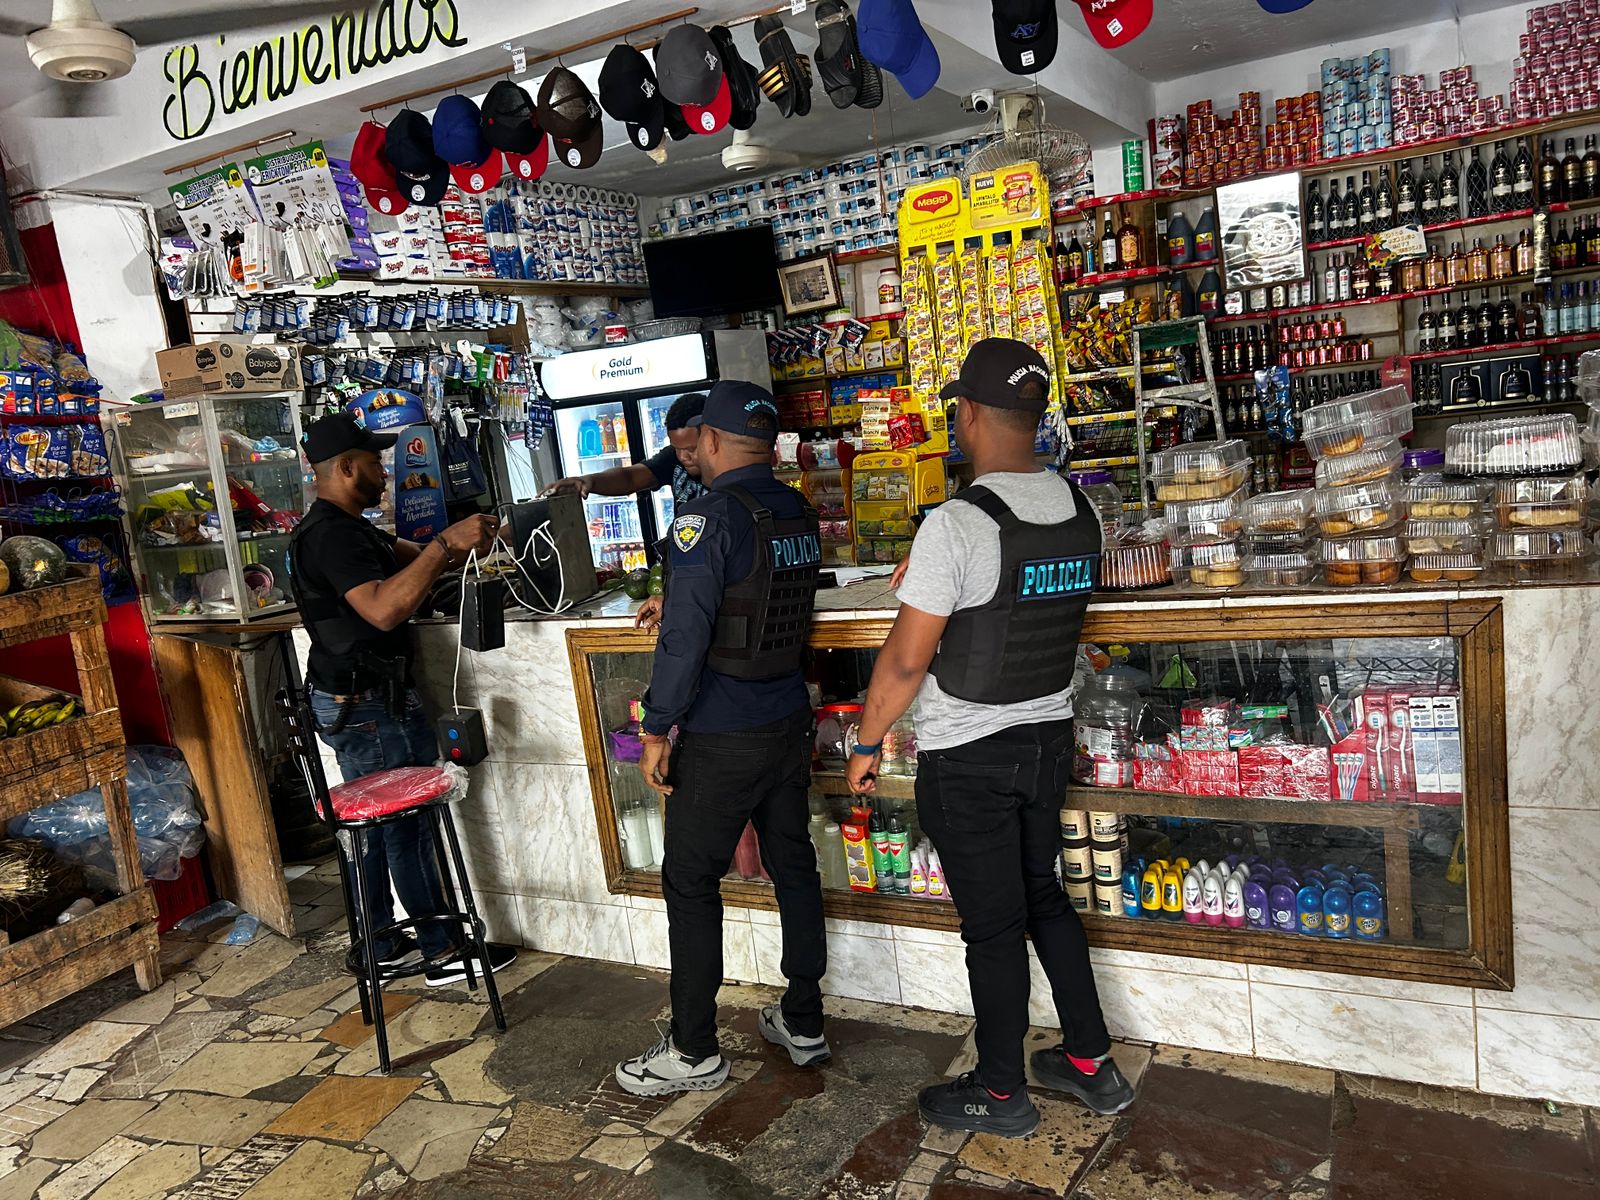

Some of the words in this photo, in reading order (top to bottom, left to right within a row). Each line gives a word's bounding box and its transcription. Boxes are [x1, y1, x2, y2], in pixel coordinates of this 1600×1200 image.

[265, 150, 307, 169] DISTRIBUIDORA
[260, 164, 292, 182] ERICKTOM
[187, 173, 224, 193] DISTRIBUIDORA
[976, 179, 994, 189] NUEVO
[917, 193, 948, 208] Maggi
[248, 358, 279, 369] Babysec
[608, 356, 633, 368] Gold
[600, 366, 644, 379] Premium
[771, 535, 820, 568] POLICIA
[1022, 559, 1092, 595] POLICIA
[964, 1103, 990, 1116] GUK
